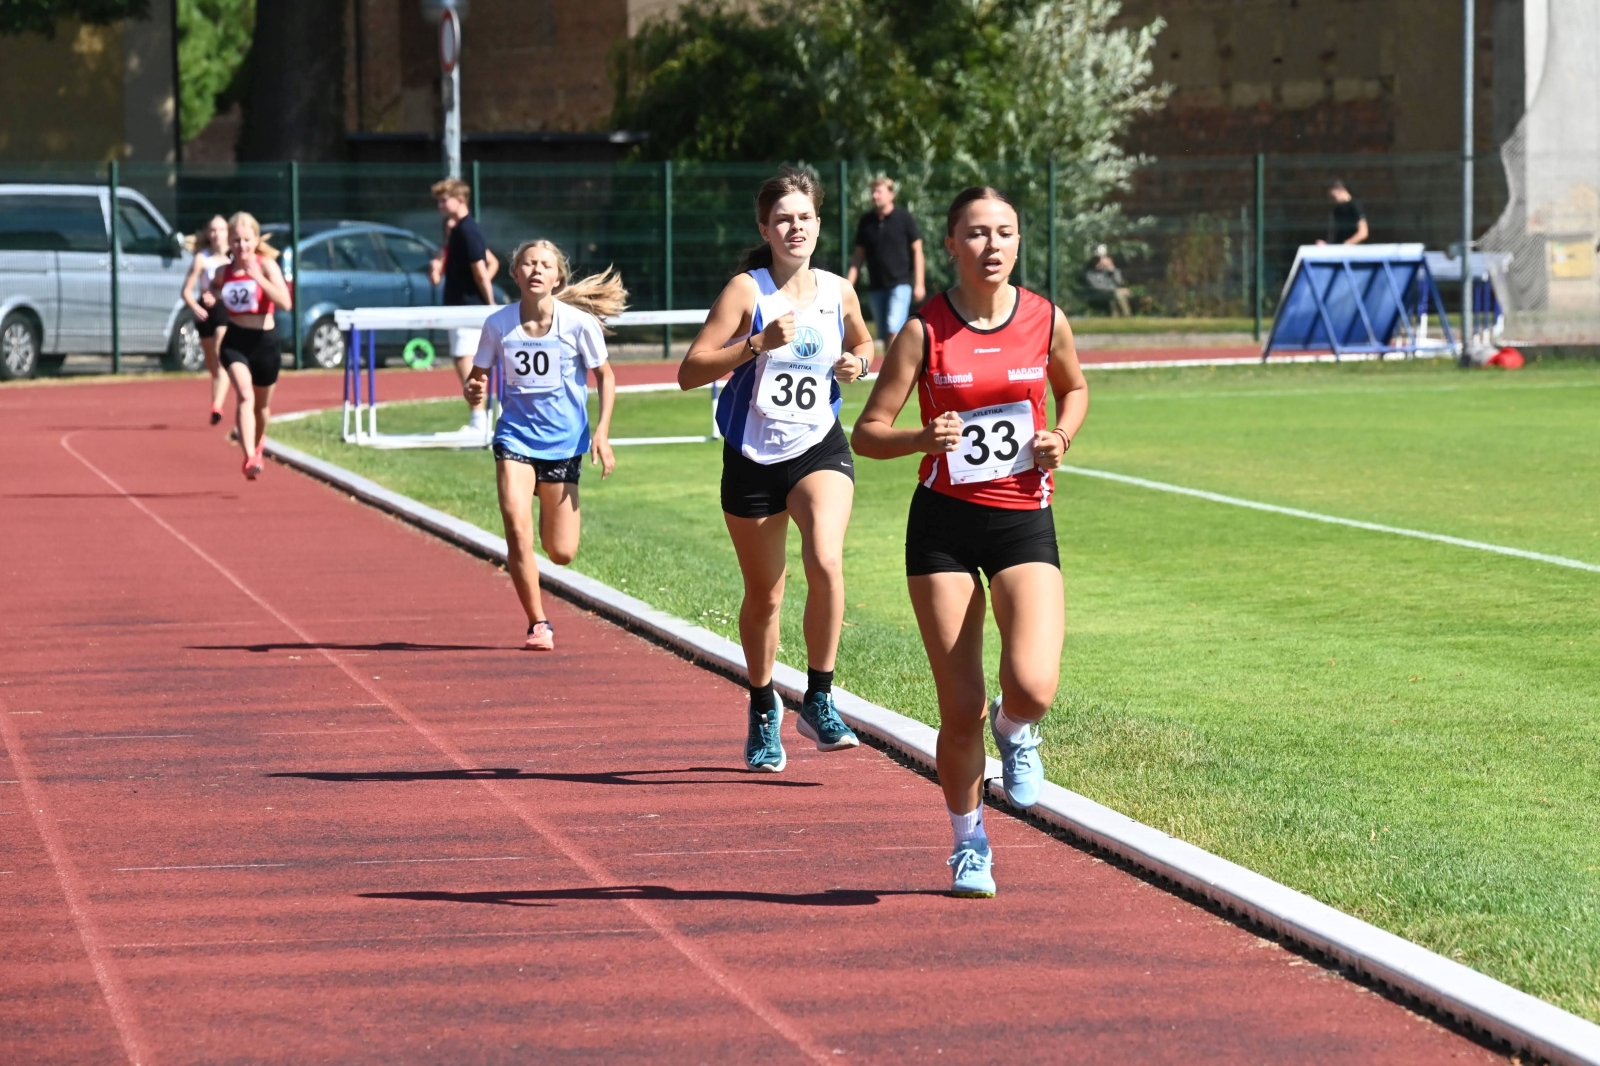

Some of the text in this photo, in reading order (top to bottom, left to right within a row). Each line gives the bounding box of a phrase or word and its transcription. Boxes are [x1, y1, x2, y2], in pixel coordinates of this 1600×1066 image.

[229, 288, 249, 306] 32
[514, 350, 549, 376] 30
[788, 363, 812, 371] ATLETIKA
[771, 373, 817, 410] 36
[972, 408, 1003, 418] ATLETIKA
[961, 420, 1019, 465] 33
